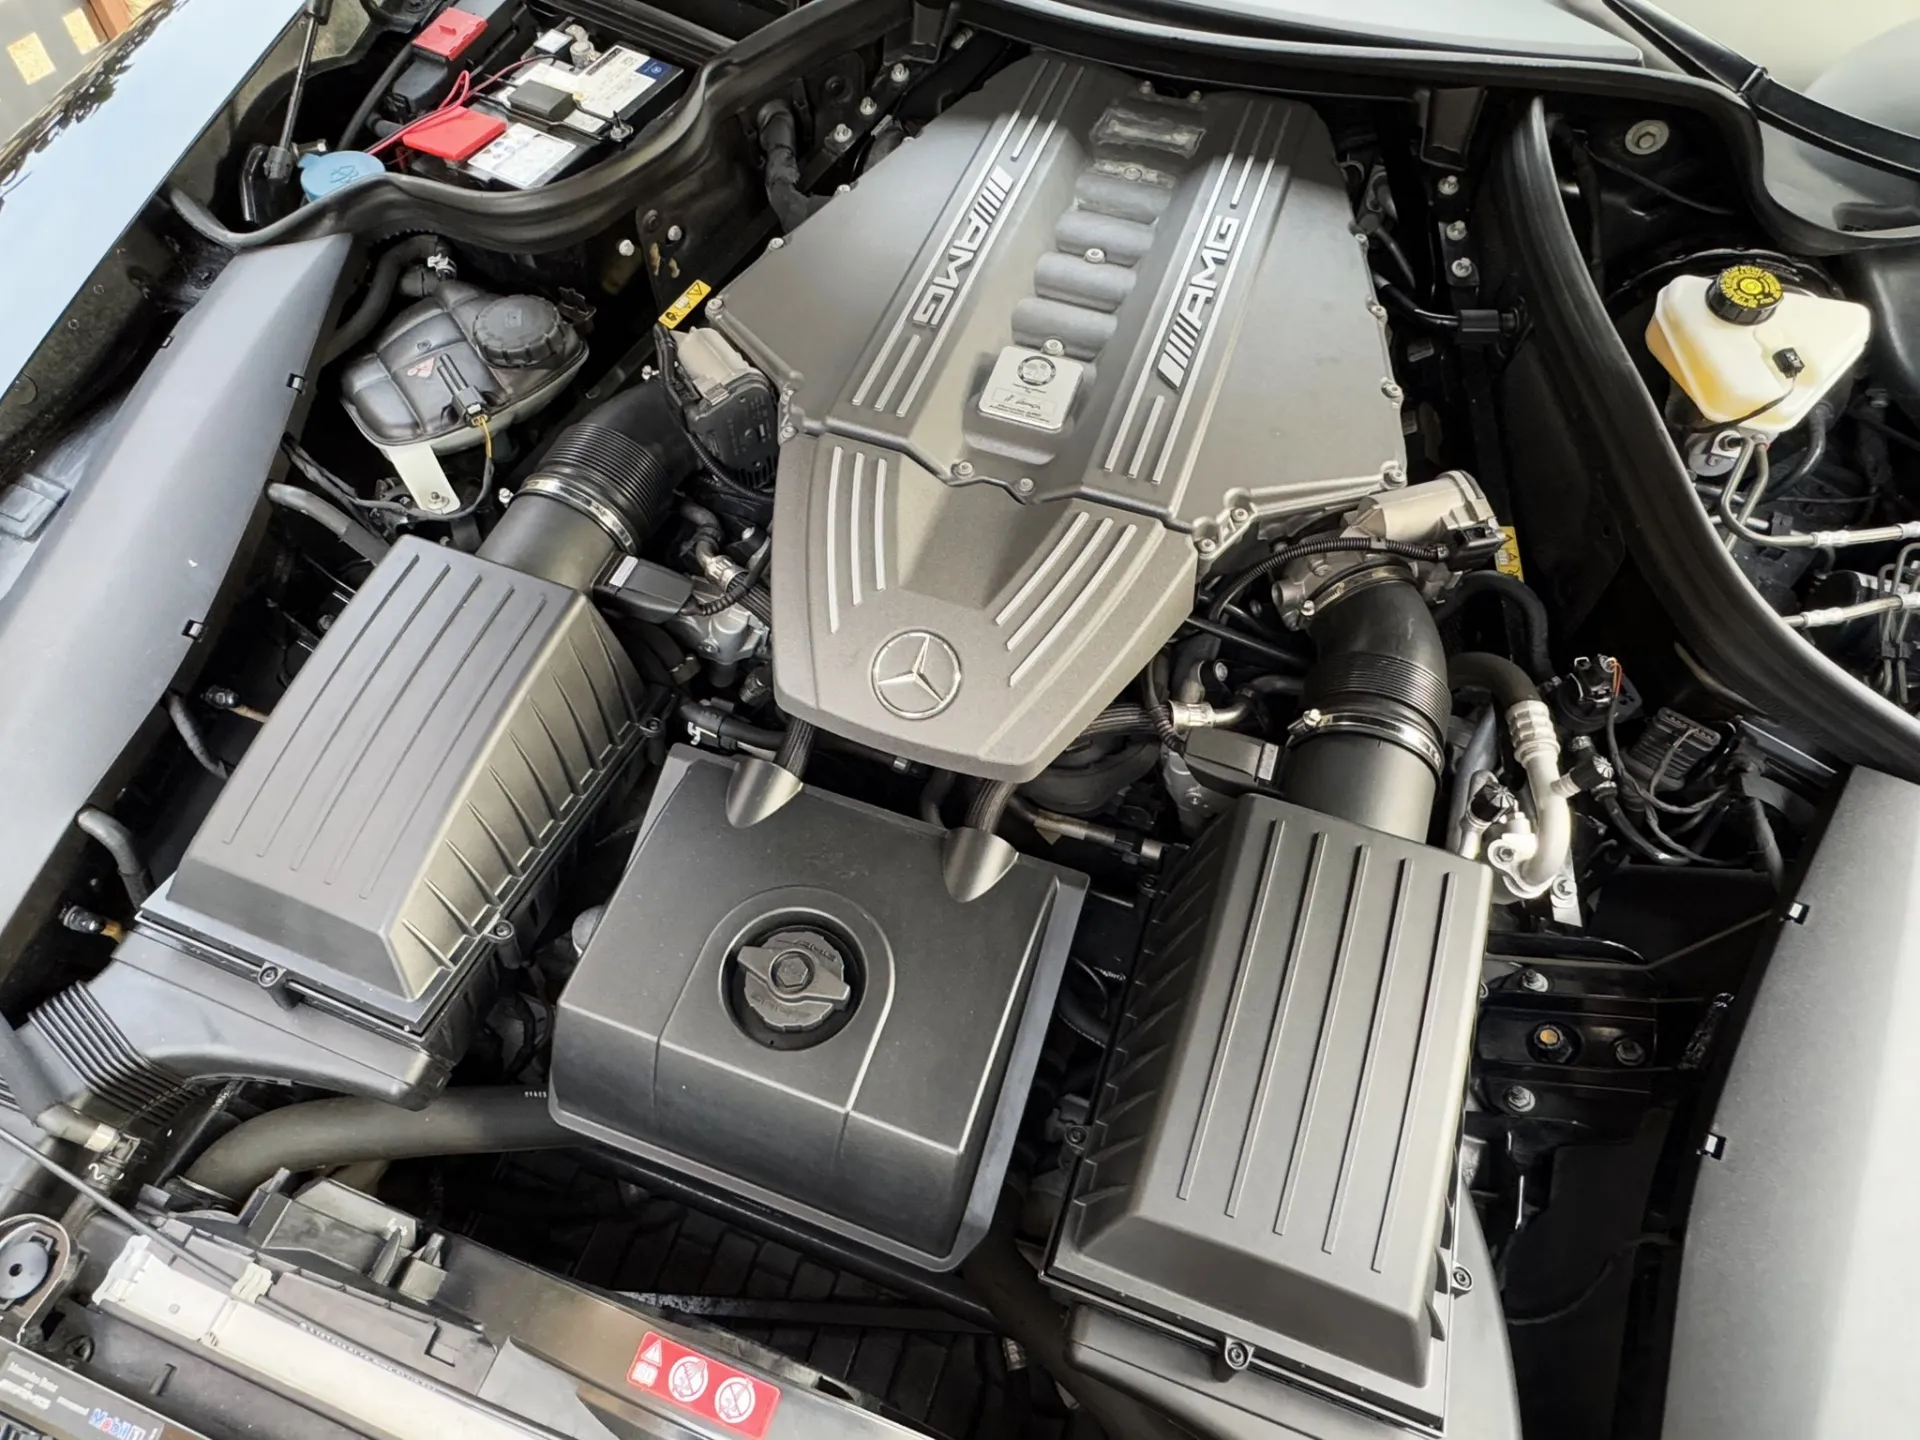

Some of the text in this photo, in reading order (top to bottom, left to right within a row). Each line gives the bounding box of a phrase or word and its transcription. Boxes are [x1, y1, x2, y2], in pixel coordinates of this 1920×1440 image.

[912, 204, 991, 328] AMG
[1178, 214, 1240, 334] AMG
[88, 1407, 131, 1440] Mobil
